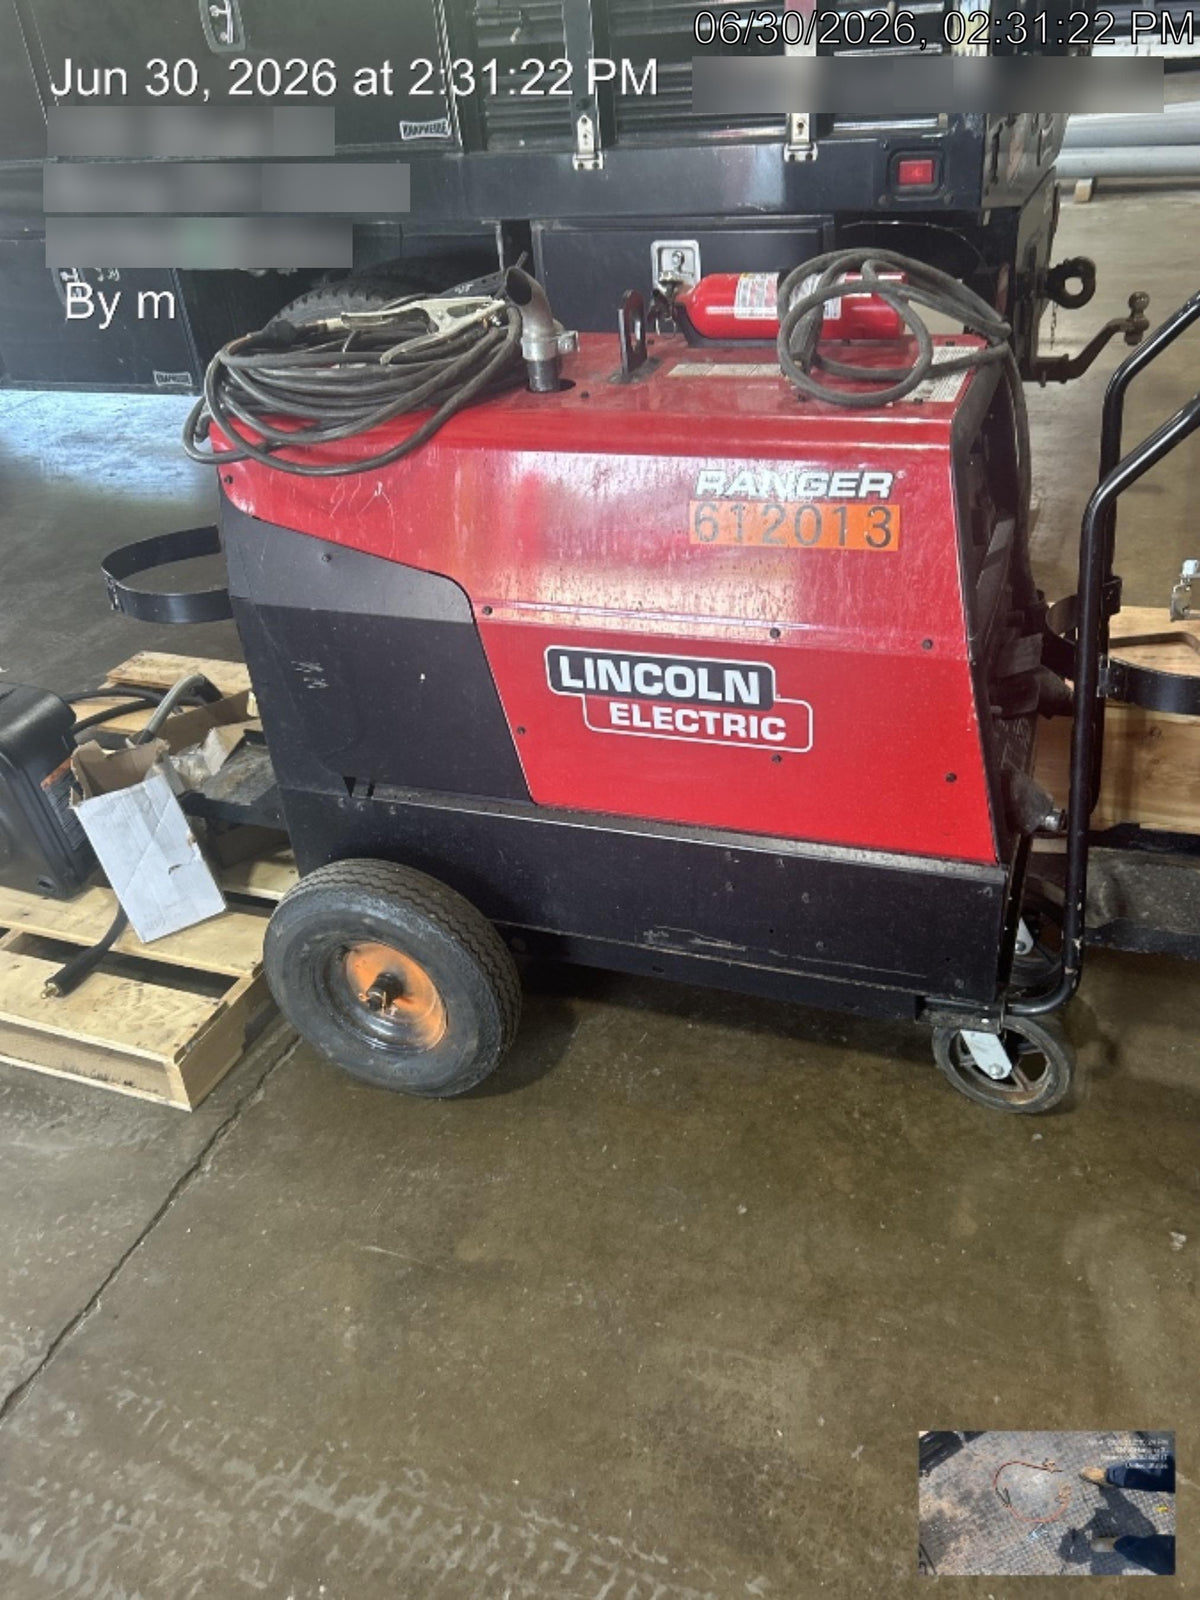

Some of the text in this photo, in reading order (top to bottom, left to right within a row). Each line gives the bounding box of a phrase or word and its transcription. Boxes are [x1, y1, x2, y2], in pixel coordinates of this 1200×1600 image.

[695, 469, 894, 499] RANGER
[694, 503, 893, 548] 612013
[559, 655, 761, 704] LINCOLN
[609, 705, 787, 742] ELECTRIC
